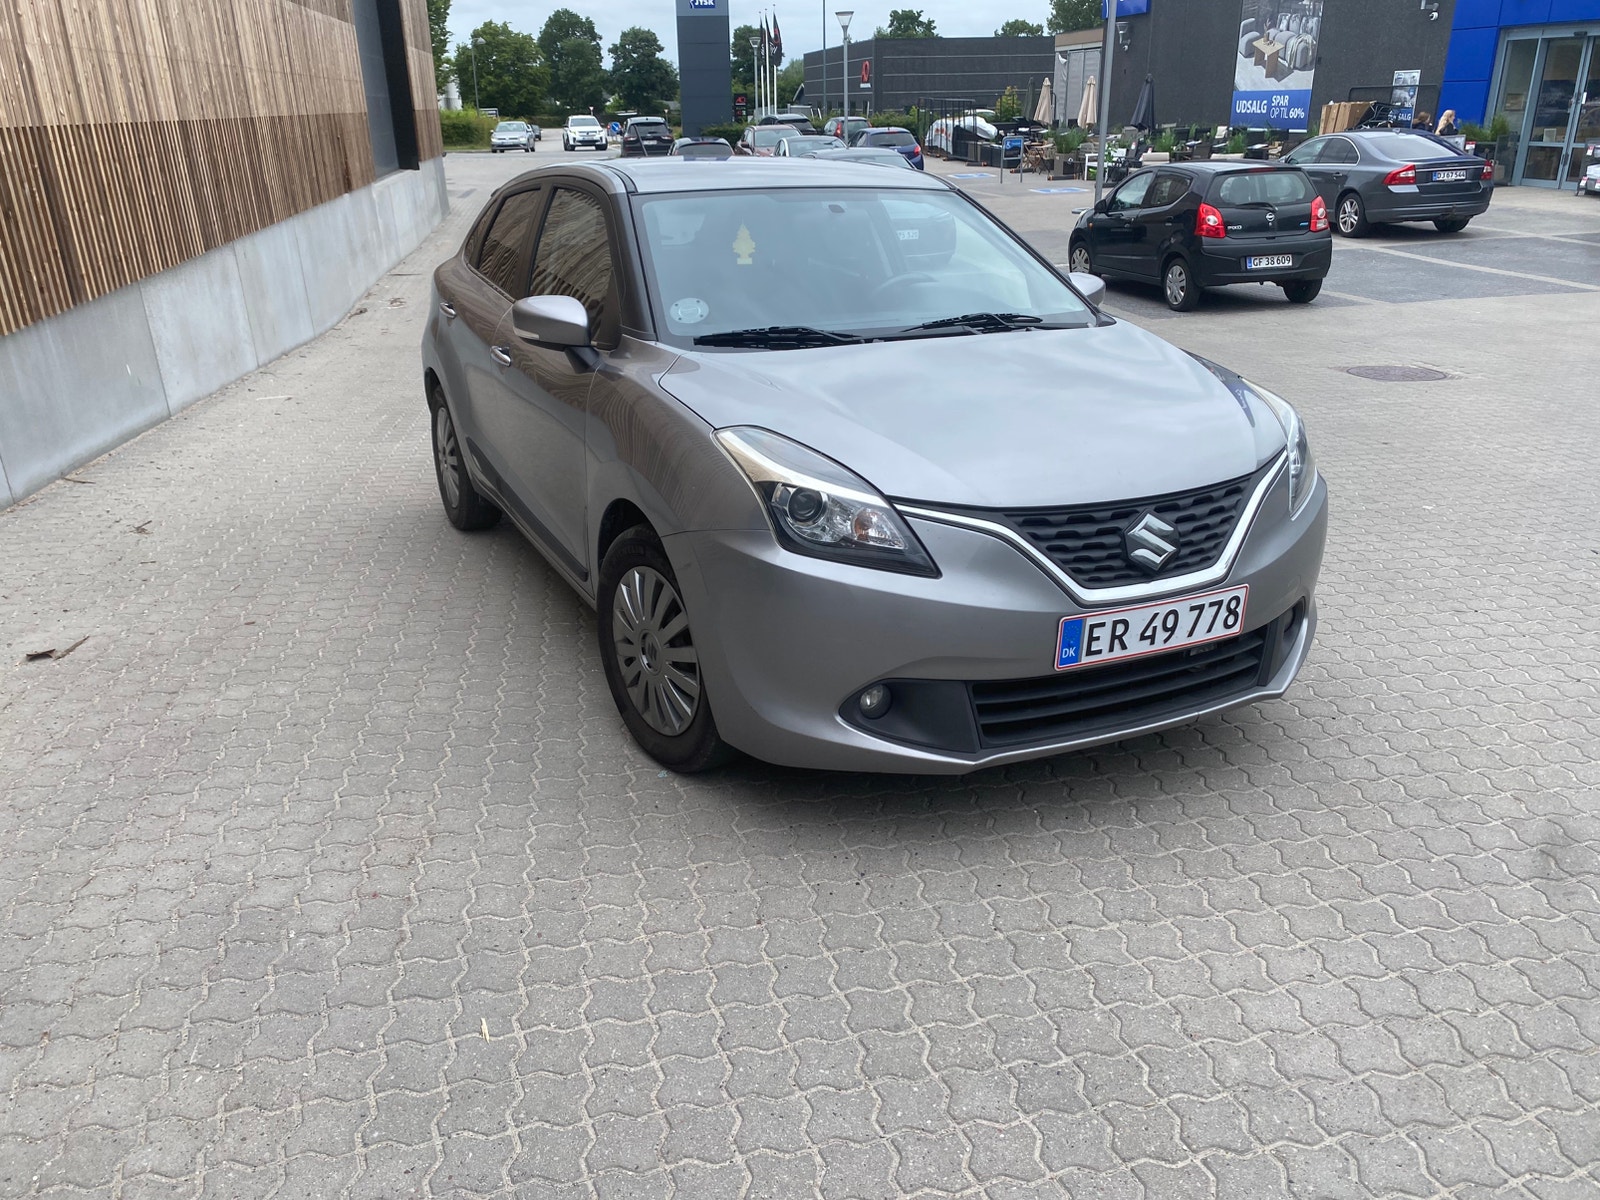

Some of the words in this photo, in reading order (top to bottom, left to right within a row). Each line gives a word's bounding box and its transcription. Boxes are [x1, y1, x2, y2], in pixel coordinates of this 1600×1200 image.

[1271, 95, 1289, 106] SPAR
[1235, 100, 1268, 114] UDSALG
[1270, 108, 1279, 119] OP
[1280, 108, 1288, 119] TIL
[1289, 107, 1305, 118] 60%
[1252, 257, 1263, 267] GF
[1265, 256, 1275, 266] 38
[1276, 255, 1291, 265] 609
[1085, 618, 1130, 657] ER
[1139, 608, 1180, 646] 49
[1187, 595, 1241, 638] 778
[1062, 646, 1076, 659] DK
